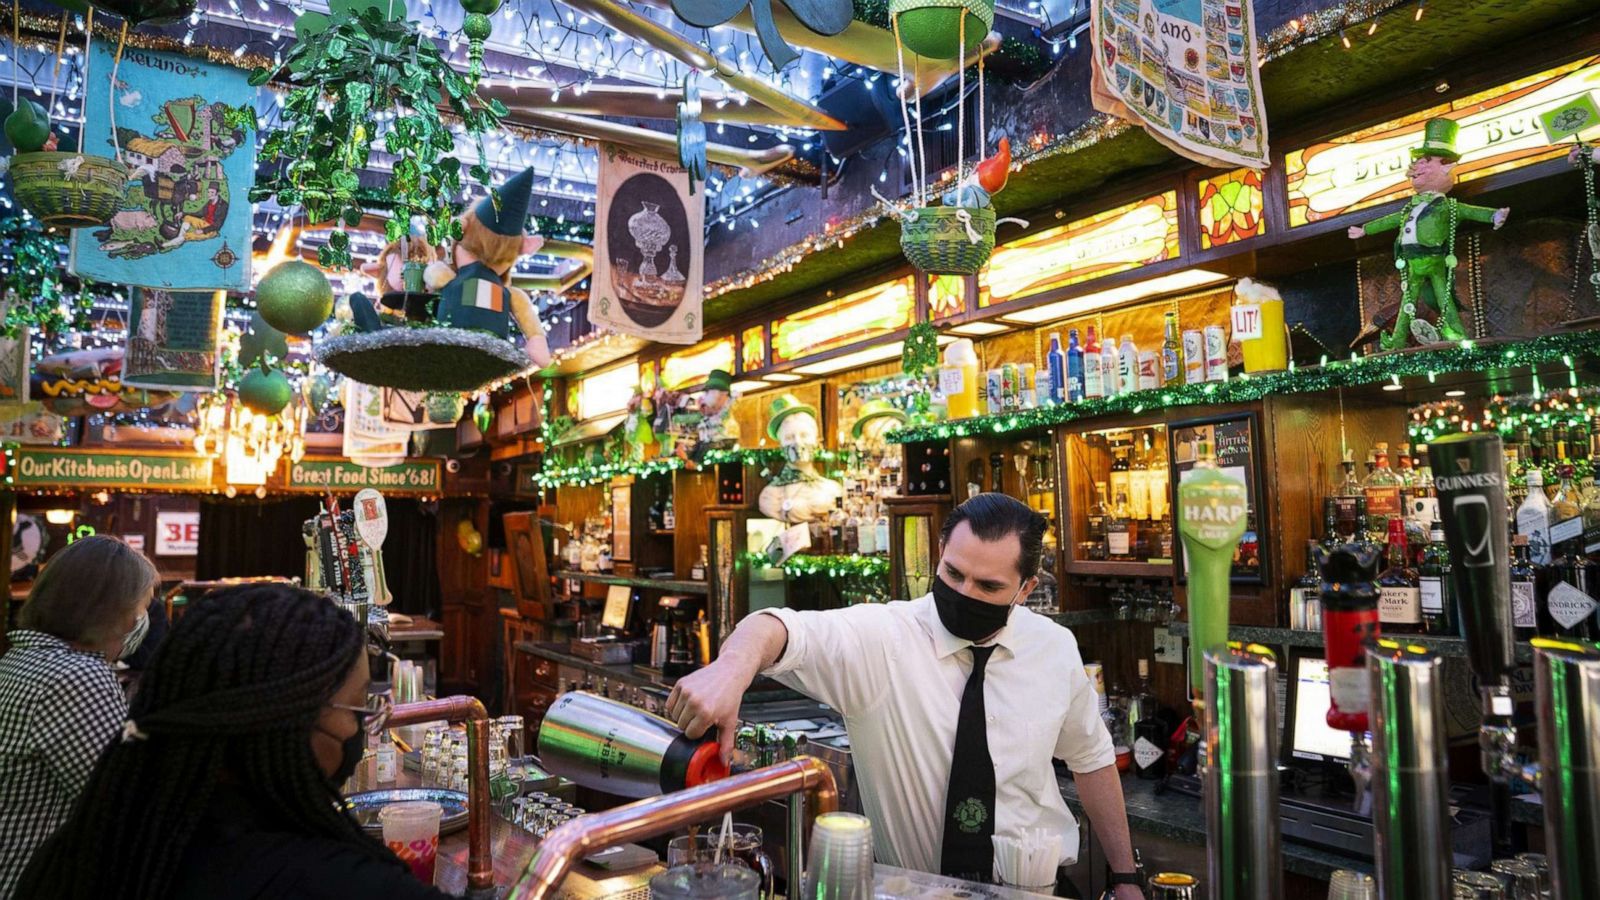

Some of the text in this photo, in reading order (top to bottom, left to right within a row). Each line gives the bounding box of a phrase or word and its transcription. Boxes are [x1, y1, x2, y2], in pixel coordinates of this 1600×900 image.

[1235, 310, 1258, 333] LIT!
[21, 456, 51, 477] Our
[52, 457, 115, 478] Kitchen
[115, 460, 128, 478] is
[129, 459, 172, 484] Open
[292, 465, 435, 485] Great Food Since '68!
[1436, 472, 1500, 491] GUINNESS
[1184, 505, 1243, 525] HARP
